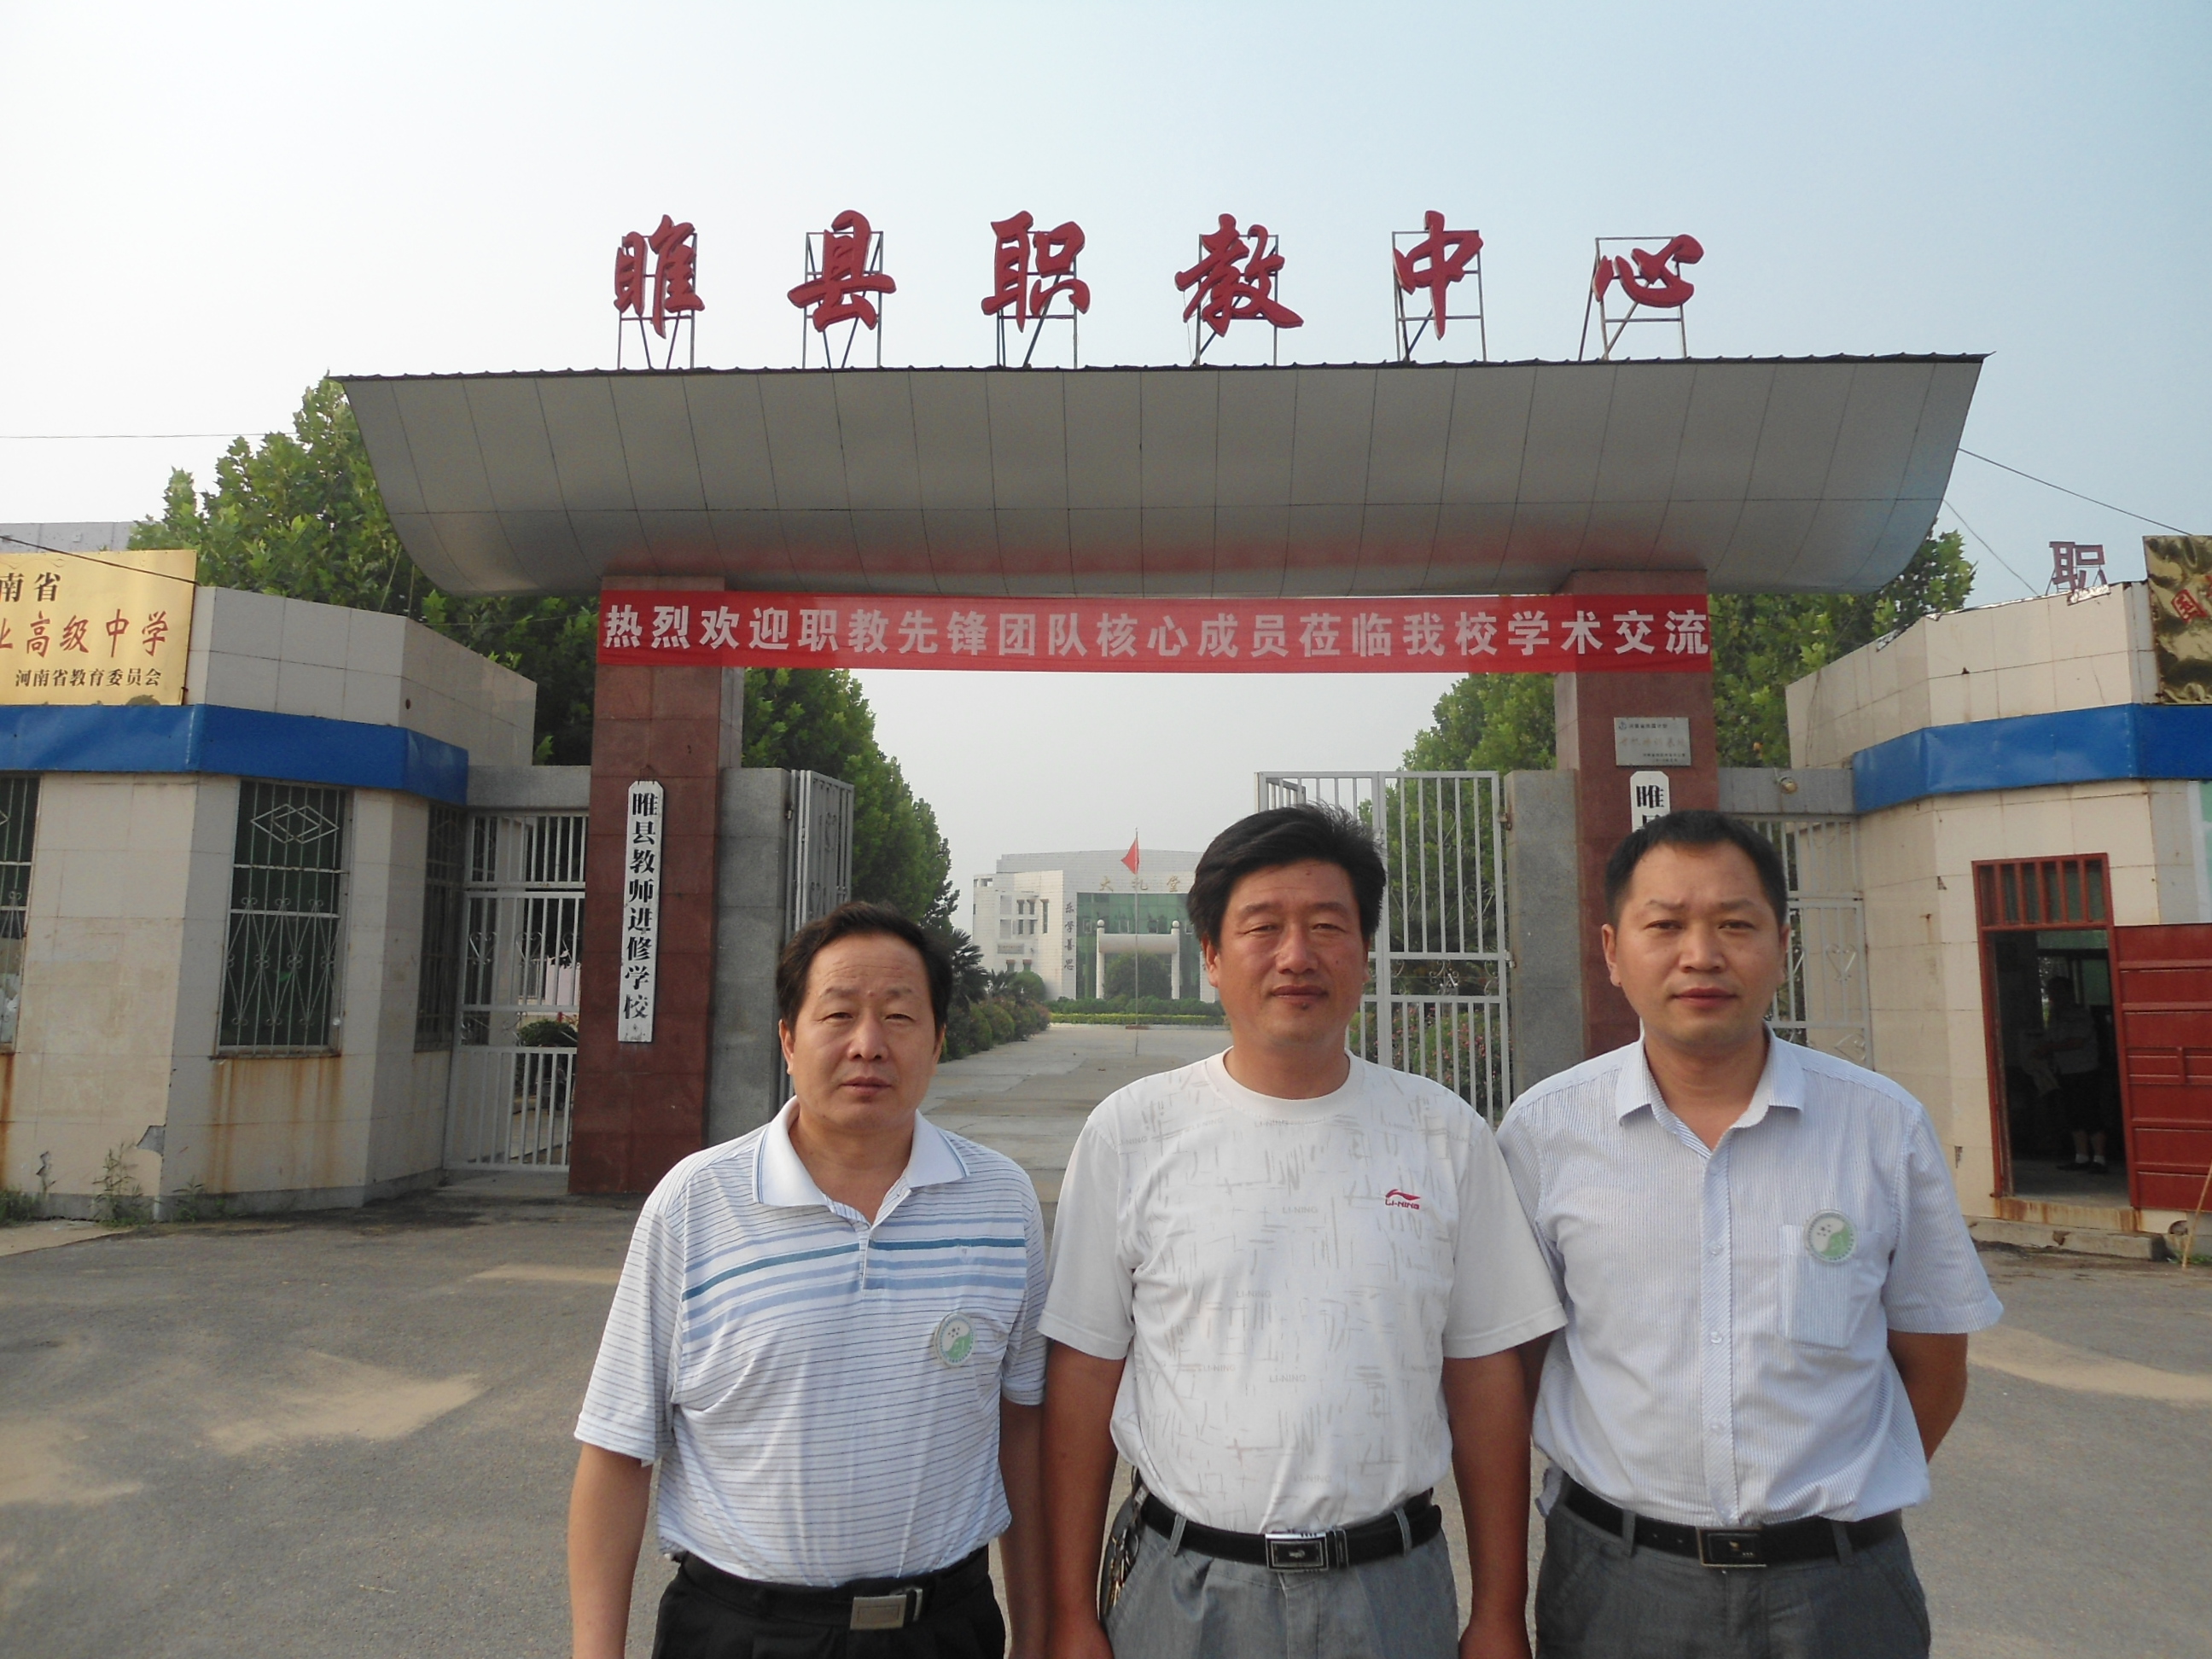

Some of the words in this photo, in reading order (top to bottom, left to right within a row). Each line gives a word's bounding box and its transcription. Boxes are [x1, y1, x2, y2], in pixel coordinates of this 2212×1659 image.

[614, 210, 1703, 340] 睢县职教中心
[0, 573, 61, 602] 南省
[603, 603, 1708, 657] 热烈欢迎职教先锋团队核心成员莅临我校学术交流
[15, 667, 162, 688] 河南省教育委员会
[1098, 875, 1180, 893] 大礼堂
[622, 792, 659, 1020] 睢县教师进修学校
[1063, 901, 1075, 971] 乐学善思
[1119, 1136, 1148, 1145] I-NING
[1282, 1206, 1318, 1214] LI-NING
[1385, 1199, 1420, 1210] LI-NING
[1236, 1290, 1272, 1299] LI-NING
